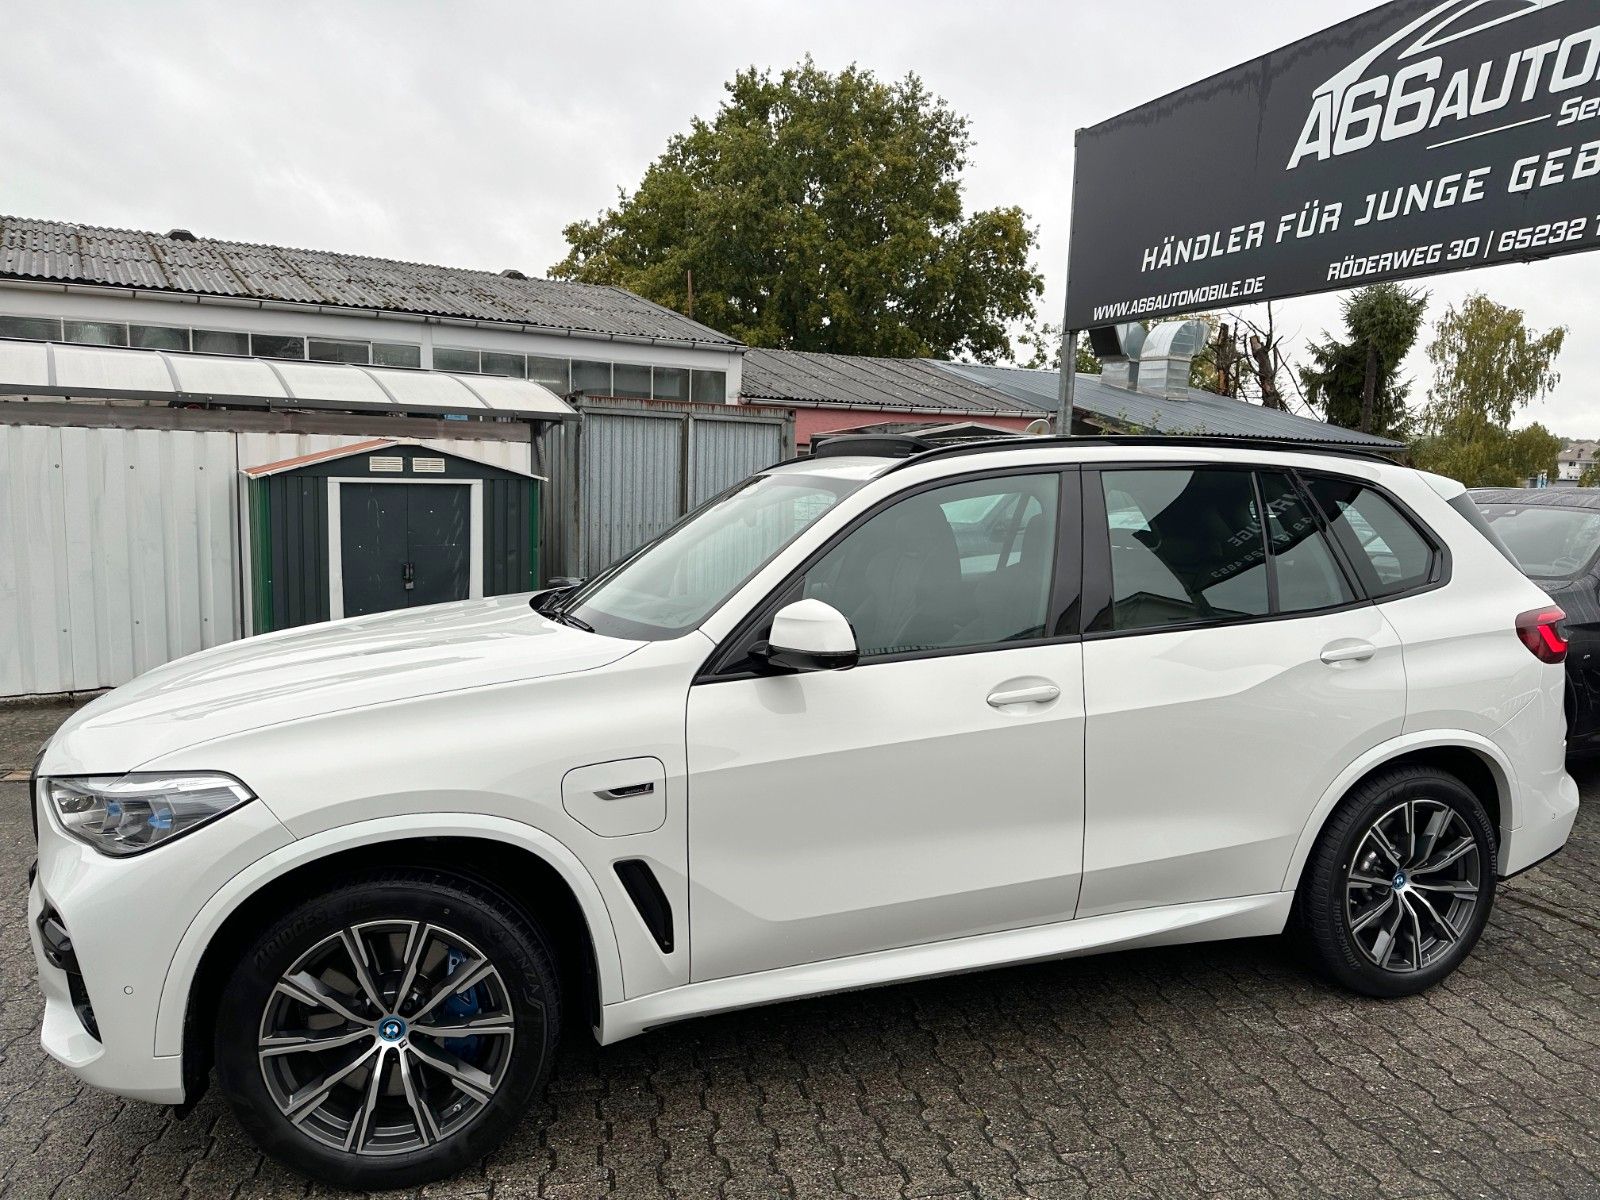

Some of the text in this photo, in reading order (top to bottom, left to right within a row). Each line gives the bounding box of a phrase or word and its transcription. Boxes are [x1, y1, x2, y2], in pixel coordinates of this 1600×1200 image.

[1286, 25, 1600, 170] A66AUTO
[1557, 96, 1600, 126] Se
[1141, 220, 1265, 272] HÄNDLER
[1276, 200, 1342, 243] FÜR
[1354, 166, 1491, 226] JUNGE
[1327, 243, 1443, 281] RÖDERWEG
[1447, 236, 1480, 260] 30
[1498, 217, 1587, 252] 65232
[1093, 276, 1265, 321] WWW.A66AUTOMOBILE.DE
[254, 894, 372, 971] BRIDGESONE
